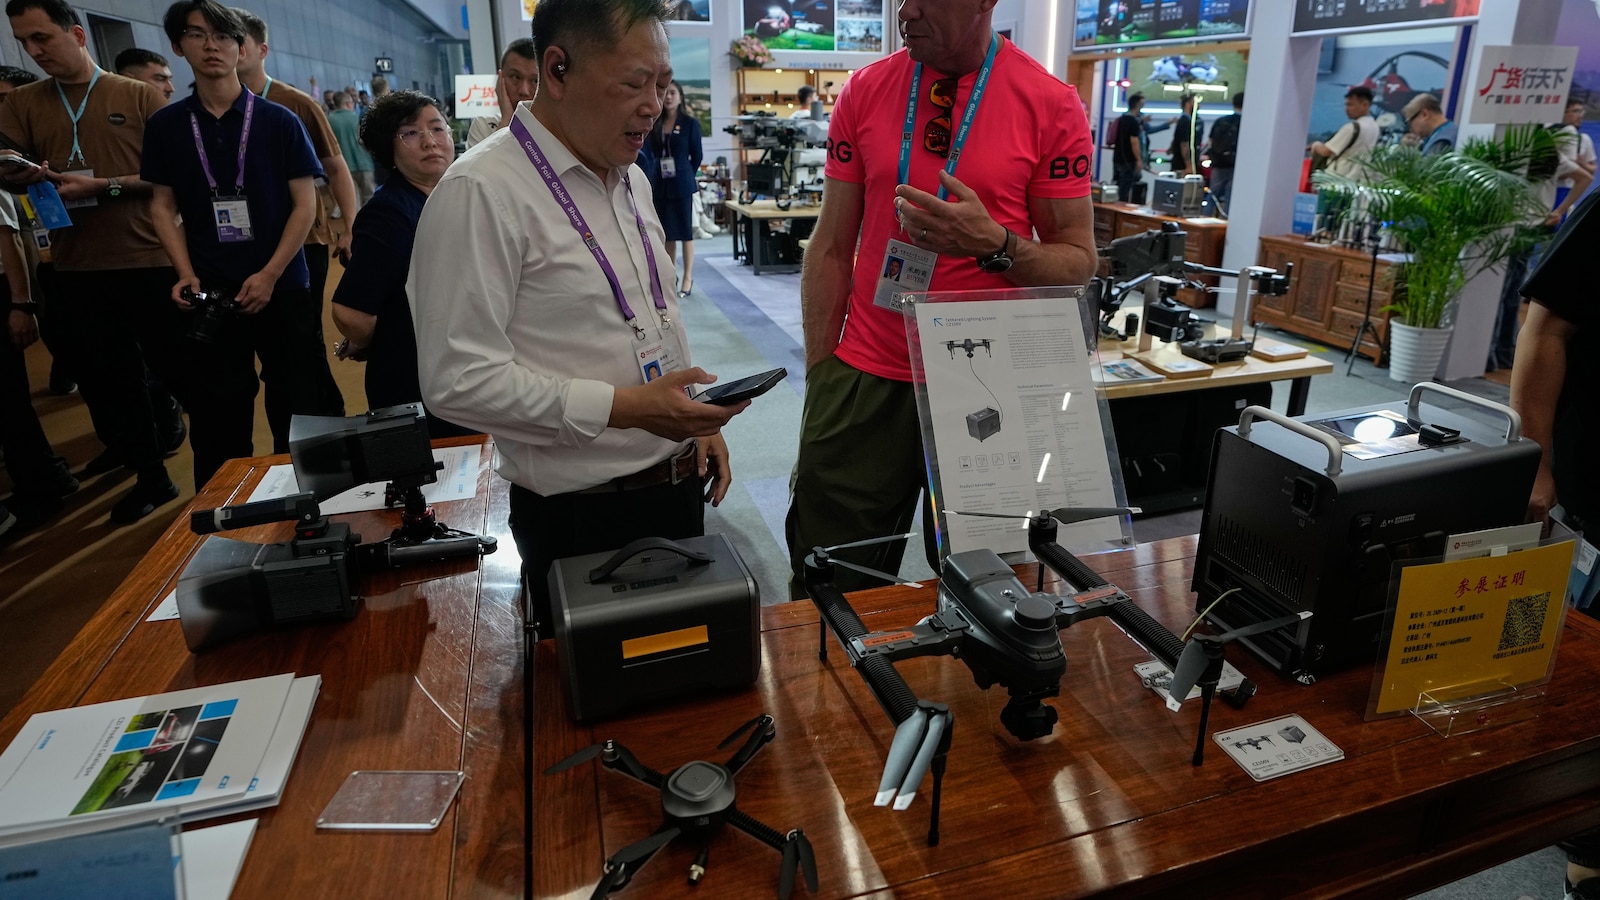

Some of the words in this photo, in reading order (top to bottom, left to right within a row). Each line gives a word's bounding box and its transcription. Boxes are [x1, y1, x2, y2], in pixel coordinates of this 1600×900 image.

[978, 67, 989, 87] Canton
[1478, 63, 1567, 96] 广货行天下
[965, 103, 976, 123] Global
[958, 124, 968, 142] Share
[1050, 154, 1092, 179] BO
[524, 140, 541, 165] Canton
[540, 166, 552, 180] Fair
[551, 182, 569, 206] Global
[567, 206, 582, 227] Share
[1454, 570, 1526, 599] 参展证明
